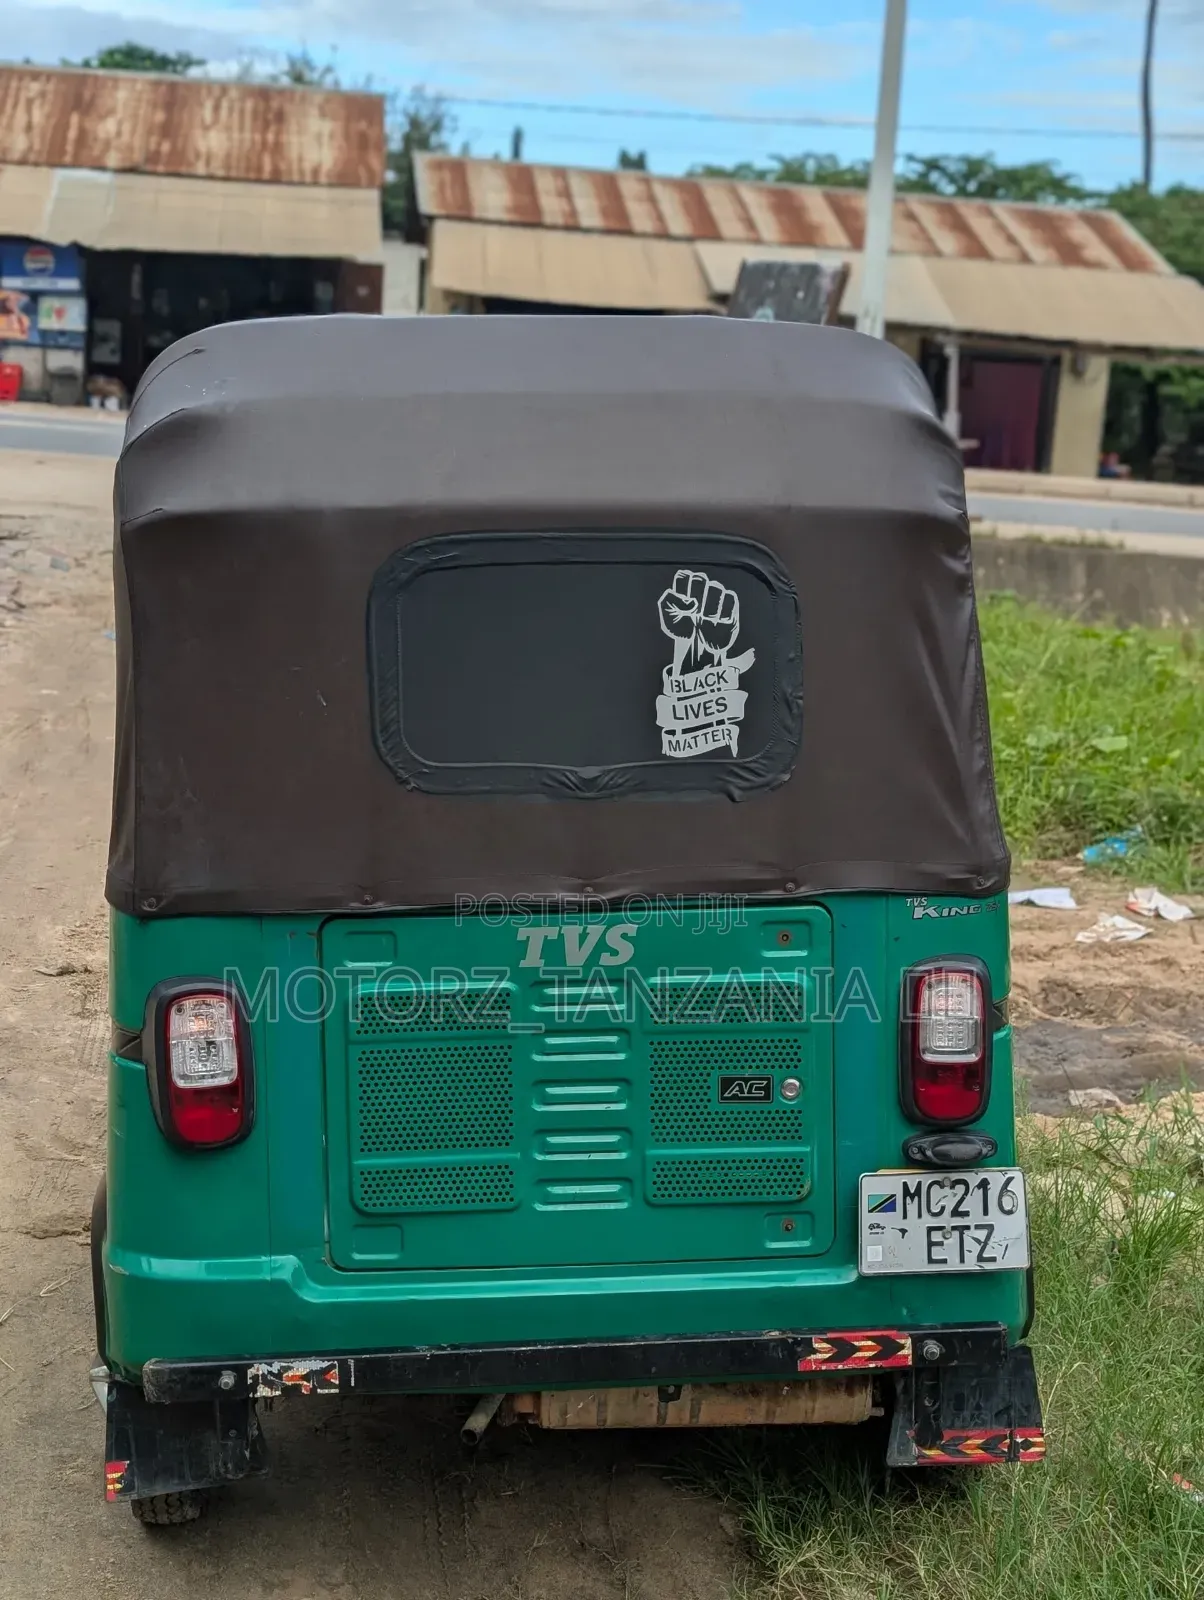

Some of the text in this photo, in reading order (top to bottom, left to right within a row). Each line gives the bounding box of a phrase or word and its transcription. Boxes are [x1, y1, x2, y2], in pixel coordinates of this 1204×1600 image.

[670, 669, 729, 693] BLACK
[672, 696, 728, 721] LIVES
[667, 728, 733, 753] MATTER
[905, 896, 928, 907] TVS
[912, 904, 982, 920] KING
[516, 923, 639, 968] TVS
[722, 1080, 769, 1097] AC
[925, 1223, 998, 1265] ETZ
